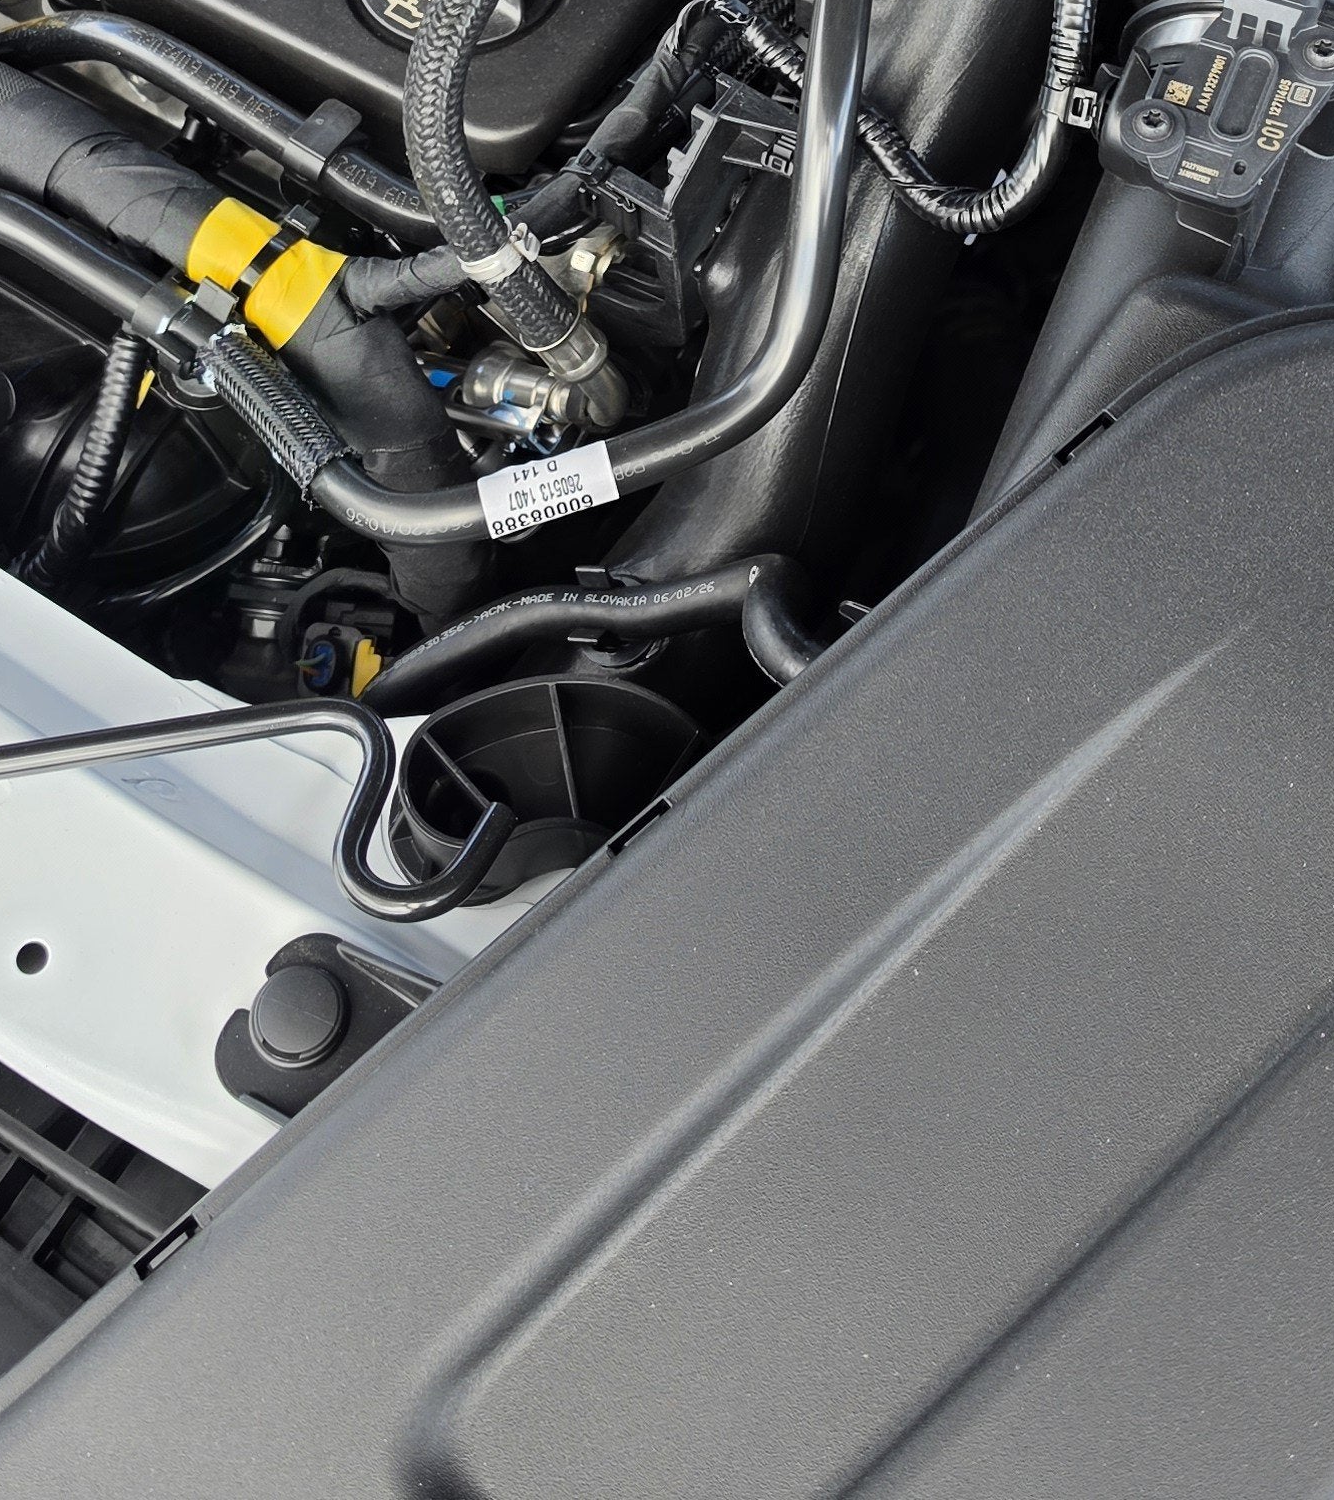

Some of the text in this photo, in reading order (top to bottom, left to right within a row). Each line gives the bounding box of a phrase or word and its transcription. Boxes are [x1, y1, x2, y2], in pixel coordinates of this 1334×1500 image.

[1254, 115, 1289, 154] C01
[511, 459, 558, 483] D 141
[508, 472, 583, 511] 260513 1407
[490, 493, 593, 535] 60008388
[559, 588, 579, 607] IN
[584, 594, 648, 607] SLOVAKIA
[651, 578, 716, 607] 06/02/26
